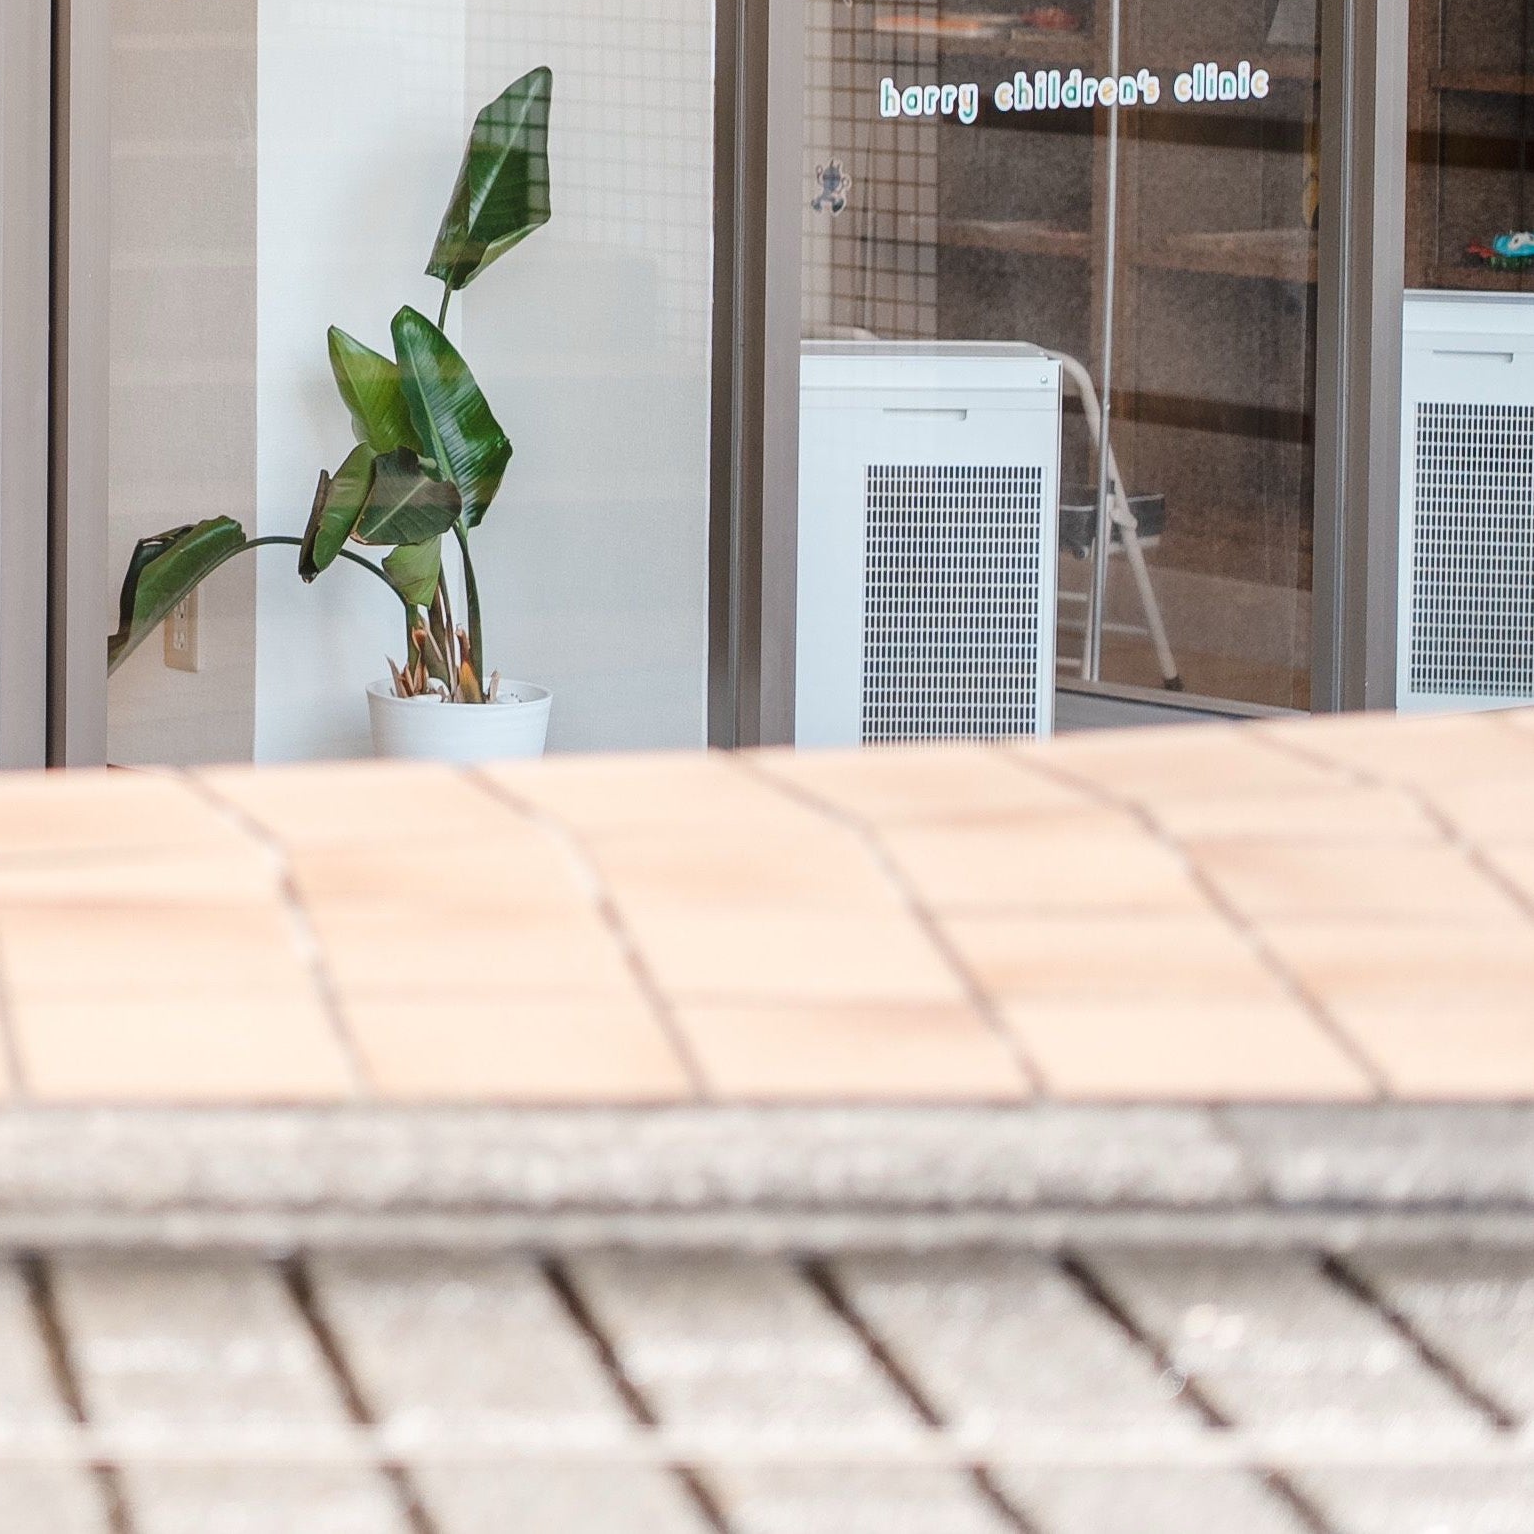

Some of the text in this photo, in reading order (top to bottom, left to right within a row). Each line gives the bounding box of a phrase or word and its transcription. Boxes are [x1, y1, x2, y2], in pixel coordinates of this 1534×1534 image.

[880, 61, 1270, 124] harry children's clinic
